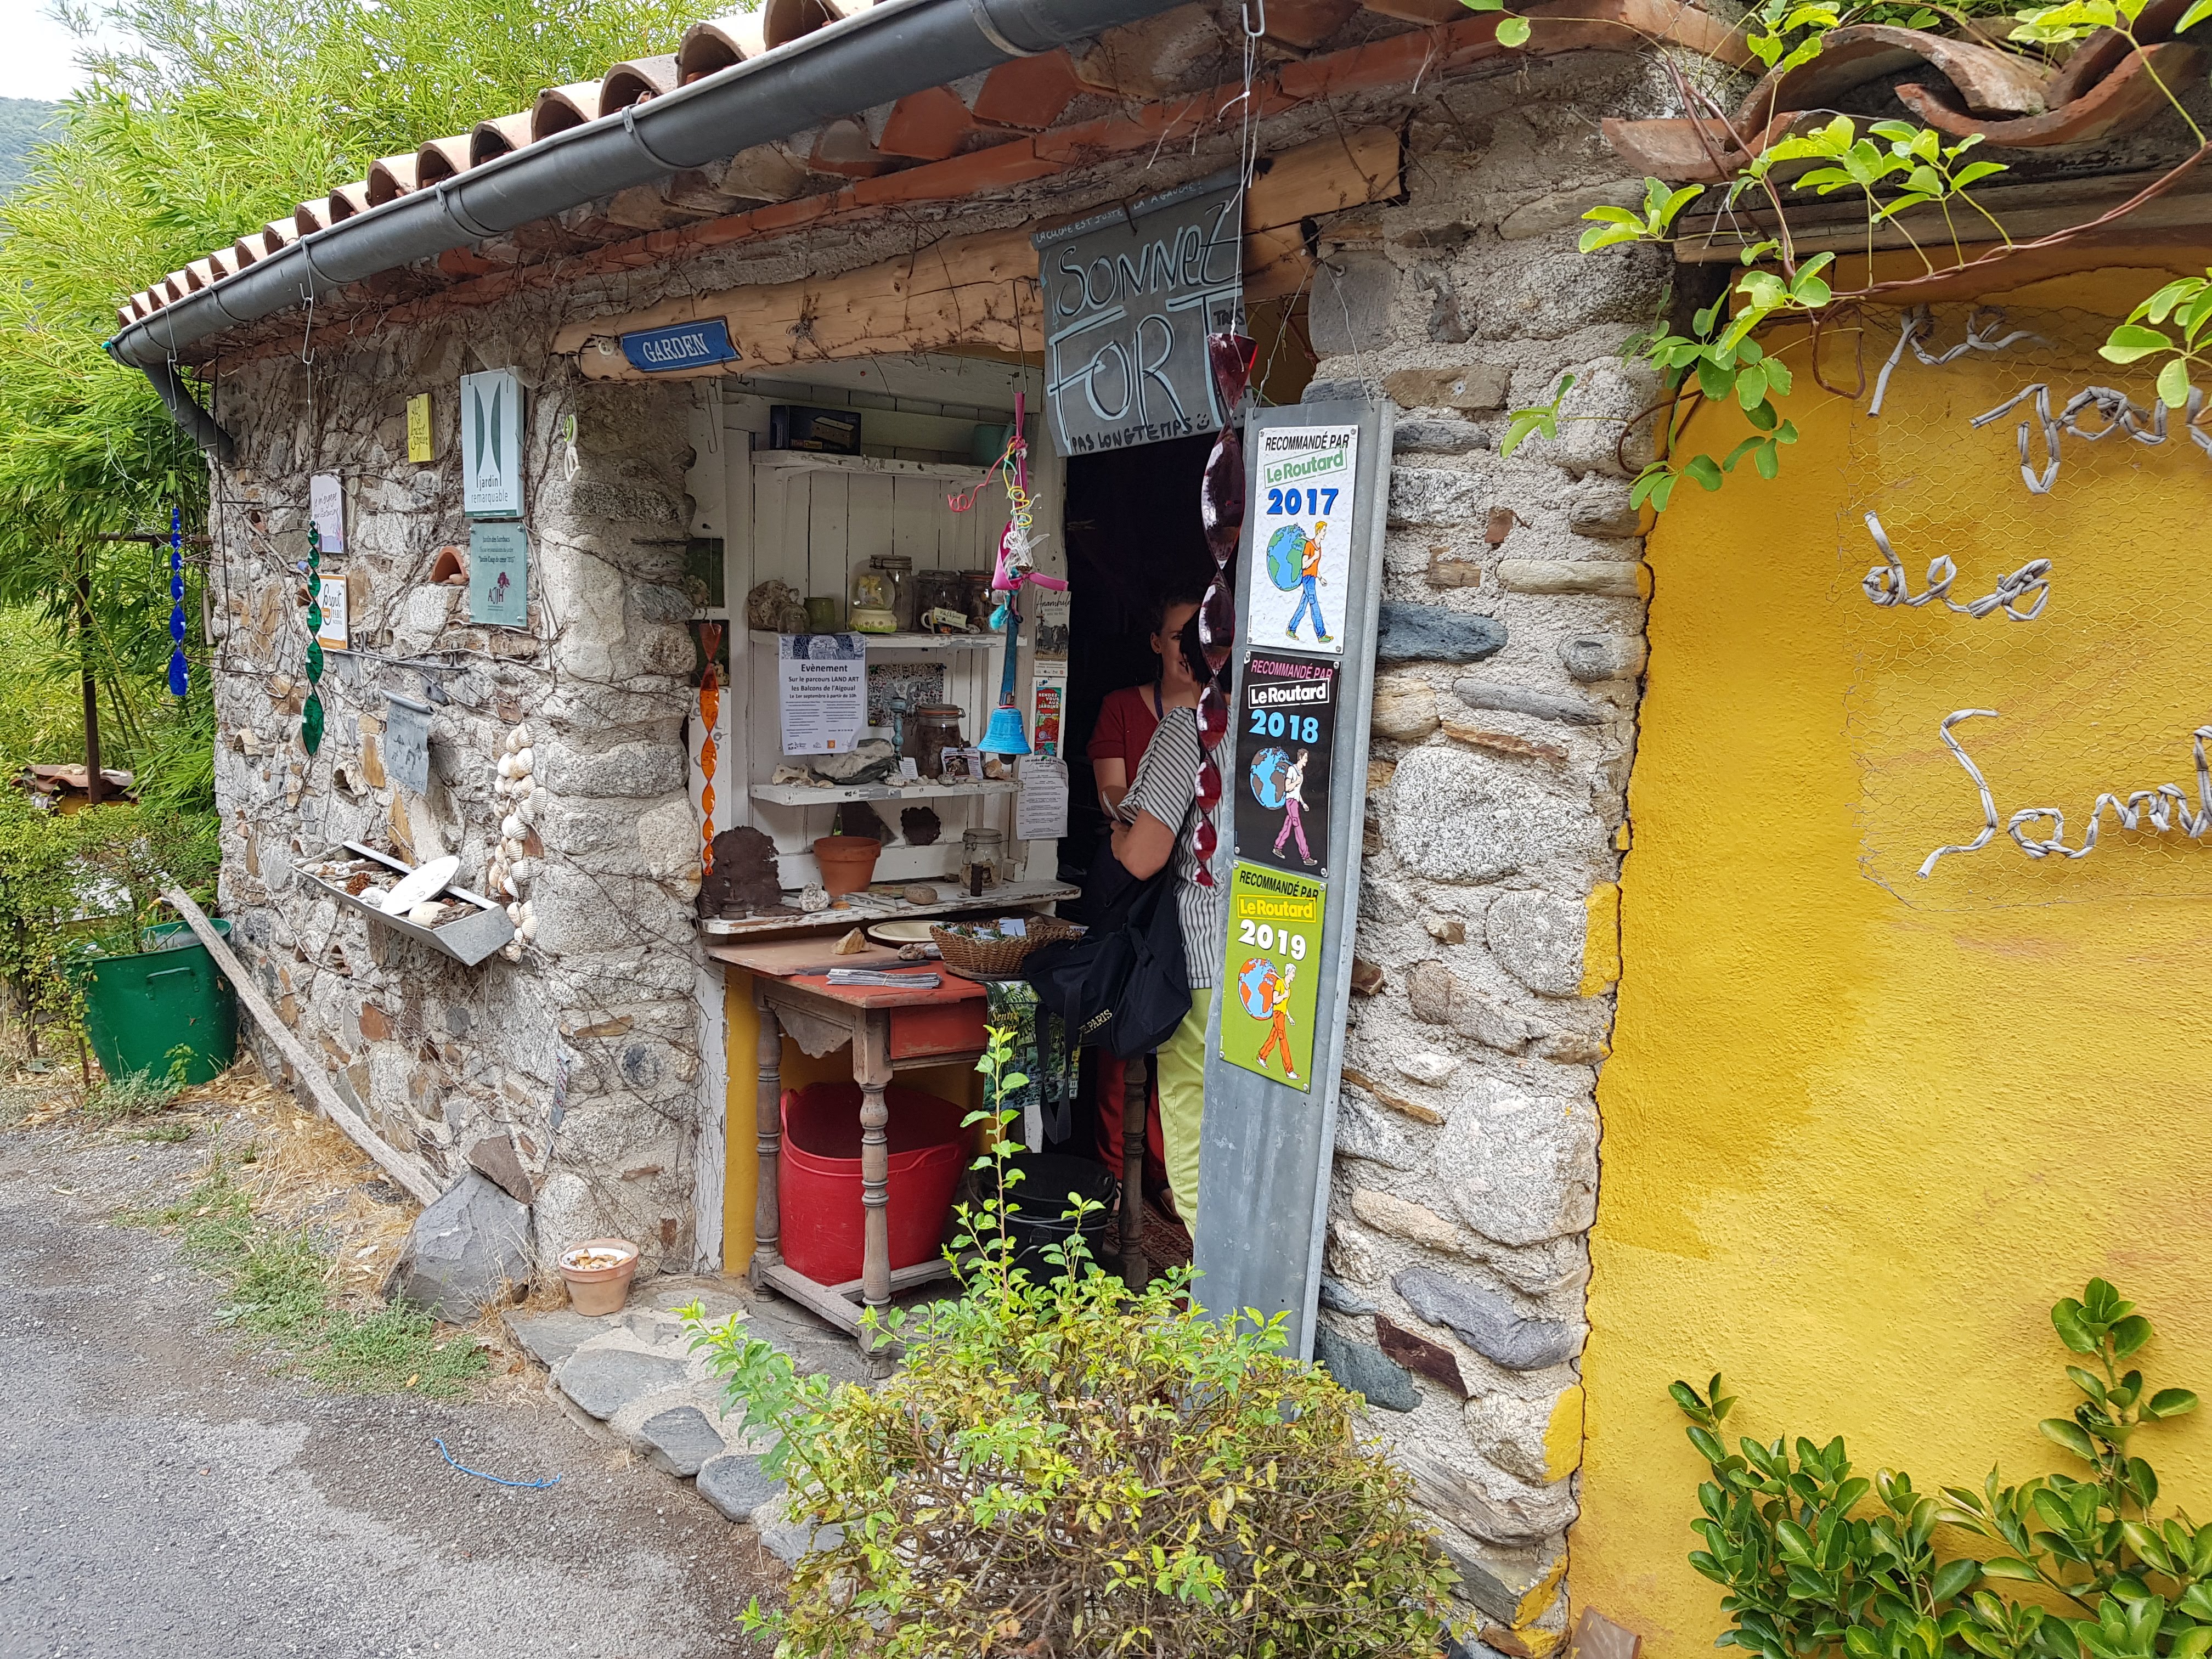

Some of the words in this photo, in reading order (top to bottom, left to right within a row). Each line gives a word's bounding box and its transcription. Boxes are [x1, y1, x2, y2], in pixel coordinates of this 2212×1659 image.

[1075, 217, 1093, 230] EST
[1095, 207, 1123, 224] JUSTE
[1159, 182, 1196, 200] GAUCHE
[642, 333, 710, 363] GARDEN
[1047, 282, 1243, 455] FORT
[1072, 433, 1094, 454] PAS
[1098, 417, 1193, 449] LONGTEMPS
[1265, 432, 1327, 451] RECOMMANDÉ
[1330, 434, 1350, 449] PAR
[471, 489, 508, 505] remarquable
[479, 475, 498, 492] jardin
[1266, 488, 1339, 515] 2017
[332, 609, 342, 619] PARC
[801, 664, 848, 672] Evènement
[1251, 659, 1313, 680] RECOMMANDÉ
[1313, 667, 1333, 682] PAR
[1249, 709, 1319, 744] 2018
[1239, 870, 1300, 898] RECOMMANDÉ
[1300, 885, 1319, 902] PAR
[1238, 919, 1306, 961] 2019
[1087, 1008, 1113, 1031] PARIS
